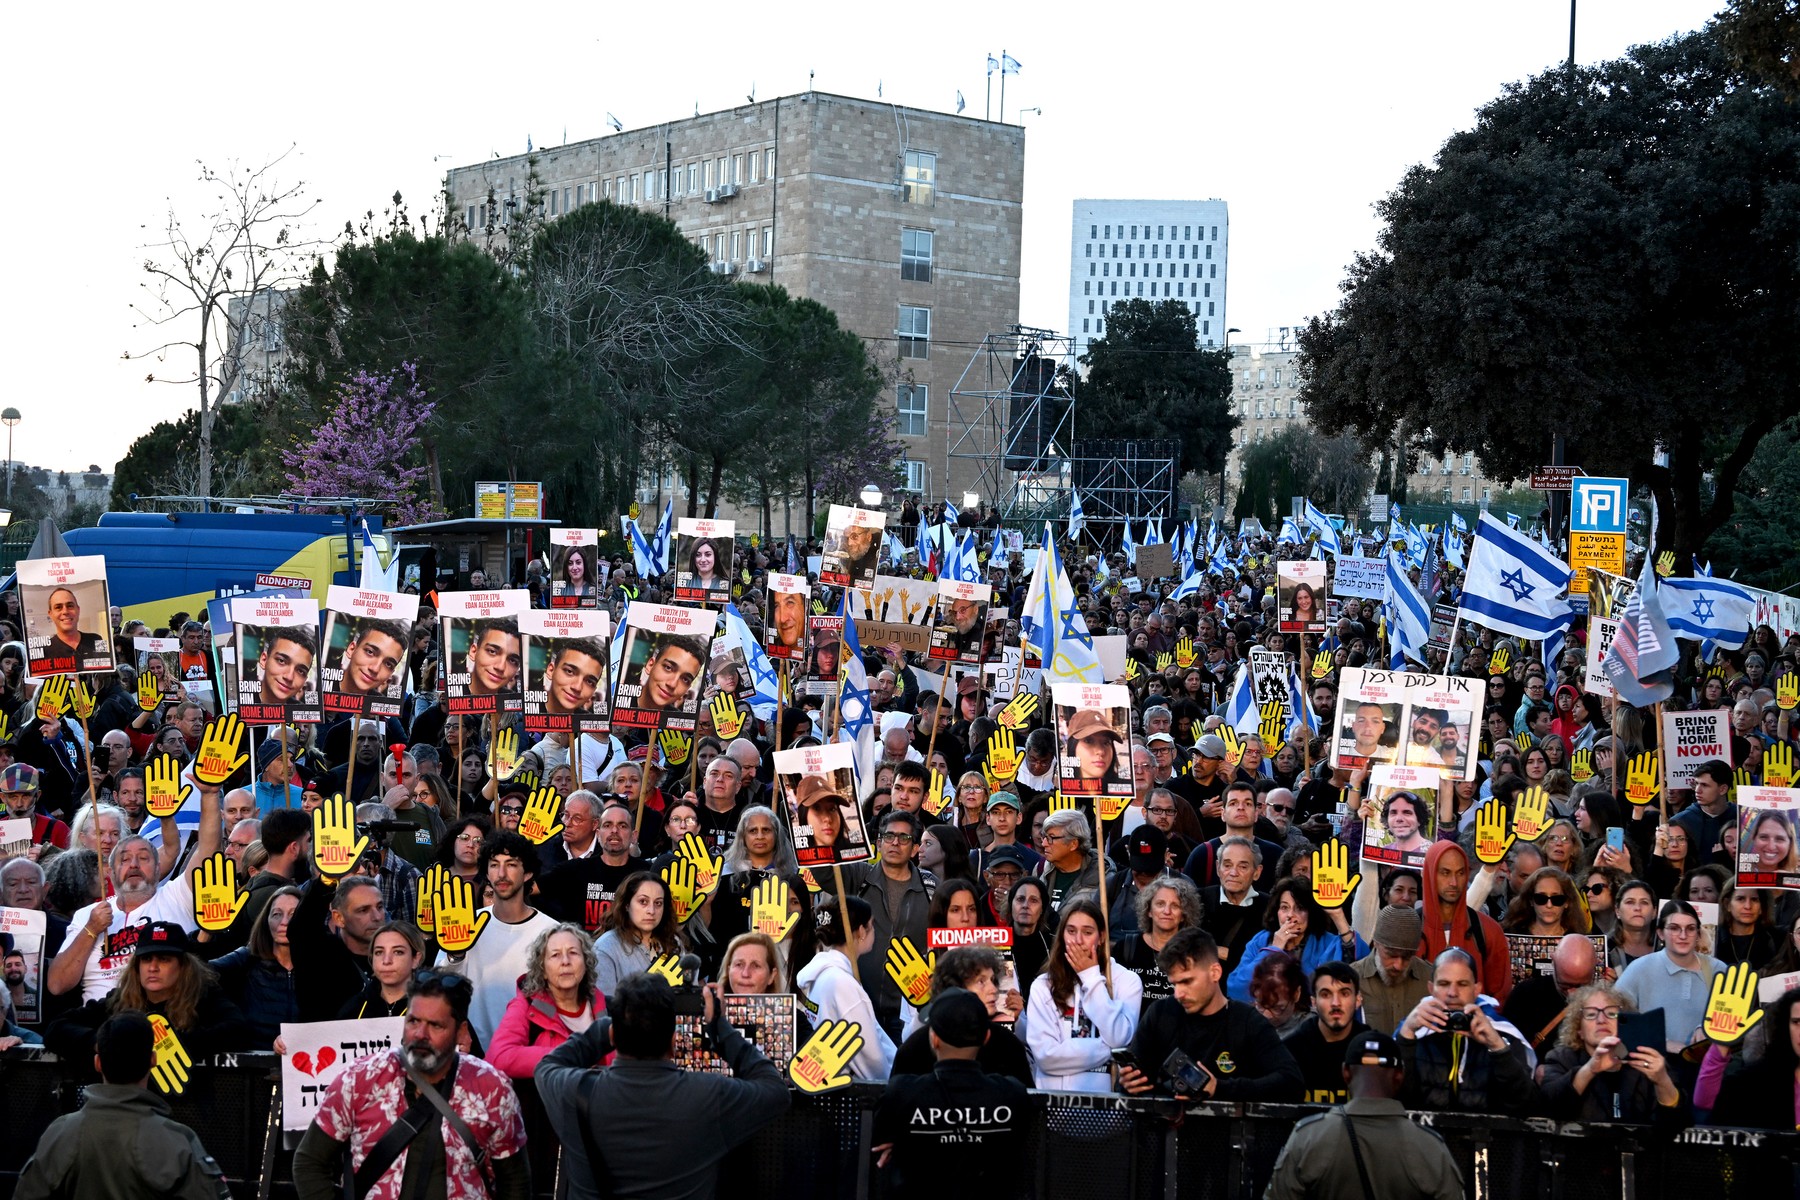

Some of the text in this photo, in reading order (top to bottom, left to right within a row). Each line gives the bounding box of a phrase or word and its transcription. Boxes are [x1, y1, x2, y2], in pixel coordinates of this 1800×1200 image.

[258, 576, 309, 588] KIDNAPPED
[352, 599, 392, 610] EDAN ALEXANDER
[269, 609, 293, 617] ALEXANDER
[544, 620, 583, 628] EDAN ALEXANDER
[653, 614, 692, 626] EDAN ALEXANDER
[28, 636, 52, 648] BRING
[29, 647, 44, 660] HIM
[31, 655, 76, 672] HOME NOW!
[447, 673, 471, 685] BRING
[1360, 670, 1470, 692] אין להם זמן
[239, 680, 262, 693] BRING
[447, 685, 463, 697] HIM
[618, 684, 642, 696] BRING
[142, 697, 156, 706] NOW
[239, 692, 254, 704] HIM
[340, 696, 364, 709] NOW!
[448, 696, 496, 710] HOME NOW!
[524, 691, 548, 703] BRING
[616, 696, 632, 708] HIM
[1780, 695, 1795, 704] NOW
[41, 703, 59, 717] NOW
[240, 706, 261, 718] HOME
[263, 705, 285, 718] NOW!
[524, 703, 540, 715] HIM
[525, 715, 572, 728] HOME NOW!
[614, 708, 660, 724] HOME NOW!
[1001, 710, 1018, 728] NOW
[1675, 716, 1717, 726] BRING
[718, 721, 737, 733] NOW
[1677, 726, 1715, 736] THEM
[1678, 735, 1717, 745] HOME
[1677, 744, 1723, 757] NOW!
[202, 756, 230, 774] NOW
[994, 760, 1013, 771] NOW
[1060, 756, 1081, 767] BRING
[1061, 767, 1074, 778] HER
[1574, 770, 1589, 778] NOW
[1672, 770, 1694, 778] ביתה
[1062, 779, 1102, 791] HOME NOW!
[1768, 776, 1789, 787] NOW
[1629, 784, 1651, 796] NOW
[151, 794, 176, 807] NOW
[525, 820, 548, 837] NOW
[792, 825, 814, 837] BRING
[1516, 819, 1538, 833] NOW
[1366, 827, 1385, 838] BRING
[794, 836, 809, 849] HER
[1365, 836, 1378, 847] HIM
[1480, 840, 1502, 853] NOW
[321, 846, 351, 862] NOW
[797, 846, 834, 860] HOME NOW!
[1365, 846, 1402, 861] HOME NOW!
[1739, 853, 1760, 863] BRING
[1739, 863, 1752, 872] HER
[587, 882, 604, 891] BRING
[1318, 883, 1344, 897] NOW
[586, 891, 616, 900] THEM HOME
[202, 902, 231, 919] NOW
[585, 900, 612, 925] NO
[11, 918, 28, 926] BERMAN
[758, 920, 783, 934] NOW
[442, 924, 471, 940] NOW
[932, 929, 1009, 945] KIDNAPPED
[908, 970, 930, 998] NOW
[1710, 1011, 1742, 1031] NOW
[796, 1054, 829, 1085] NOW
[910, 1106, 1012, 1125] APOLLO
